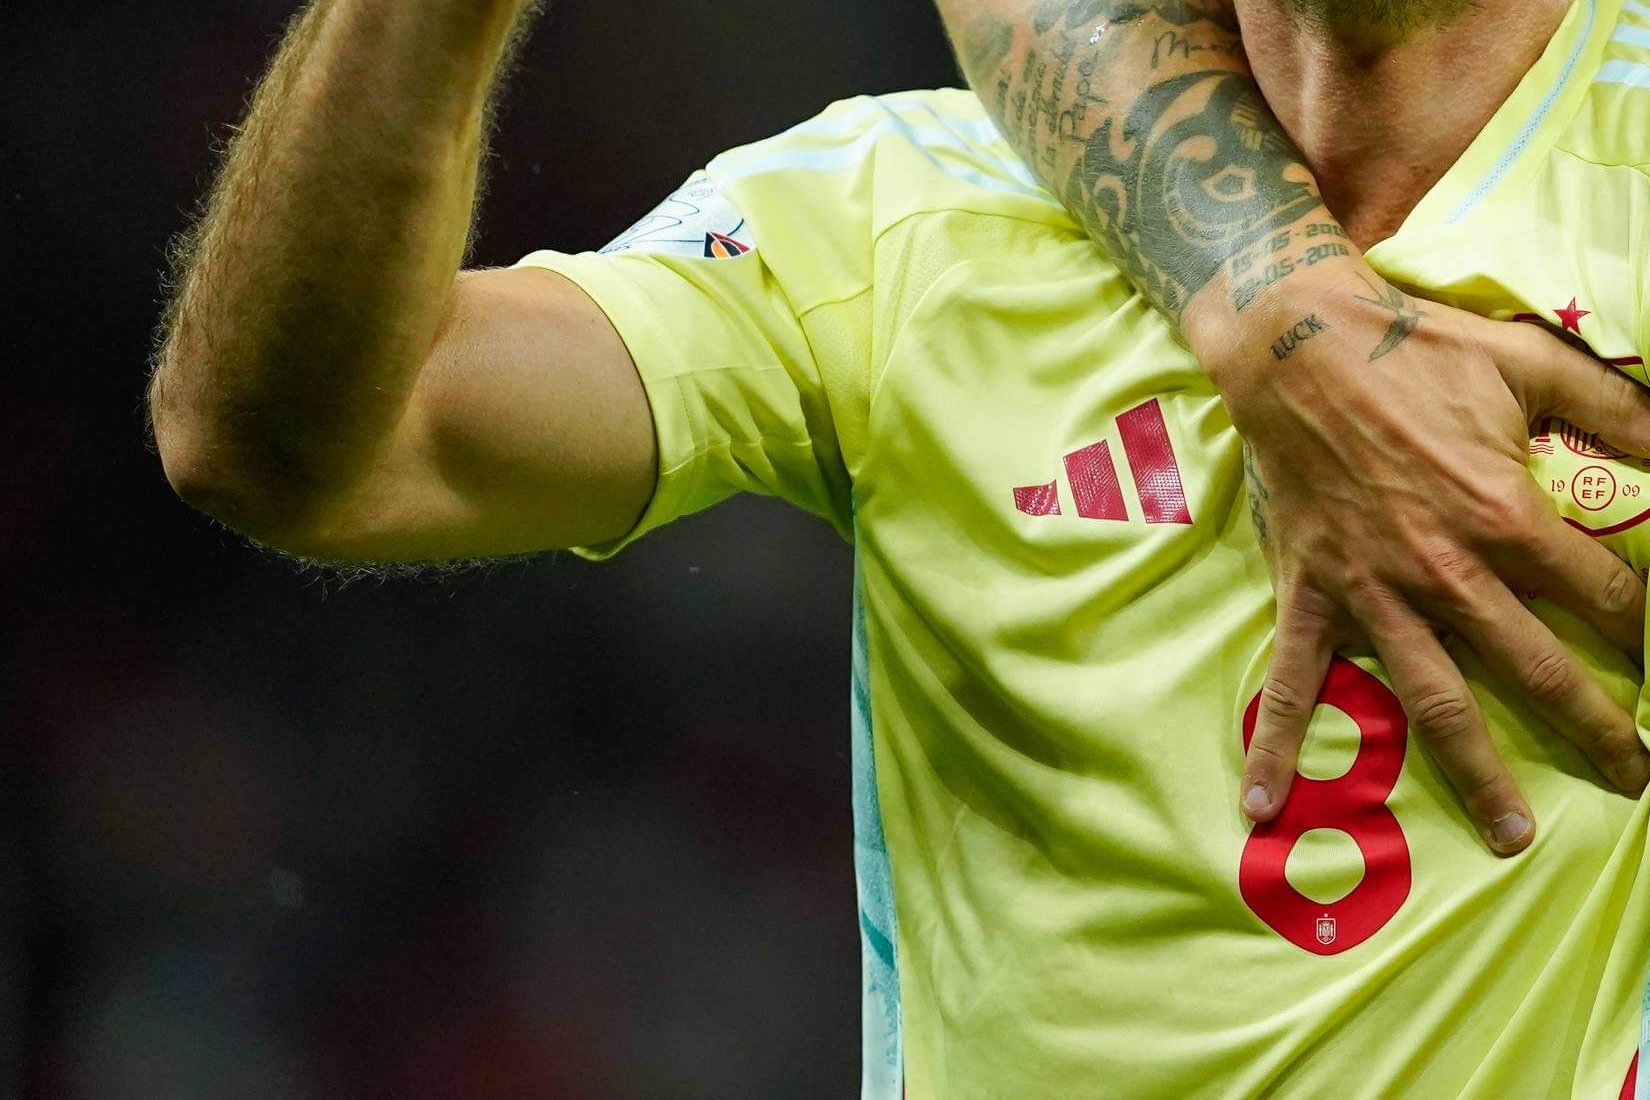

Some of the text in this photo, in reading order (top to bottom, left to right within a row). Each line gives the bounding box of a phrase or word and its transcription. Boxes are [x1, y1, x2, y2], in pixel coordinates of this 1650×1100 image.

[1270, 314, 1323, 360] LUCK
[1551, 479, 1641, 498] 19 09
[1239, 654, 1412, 956] 8
